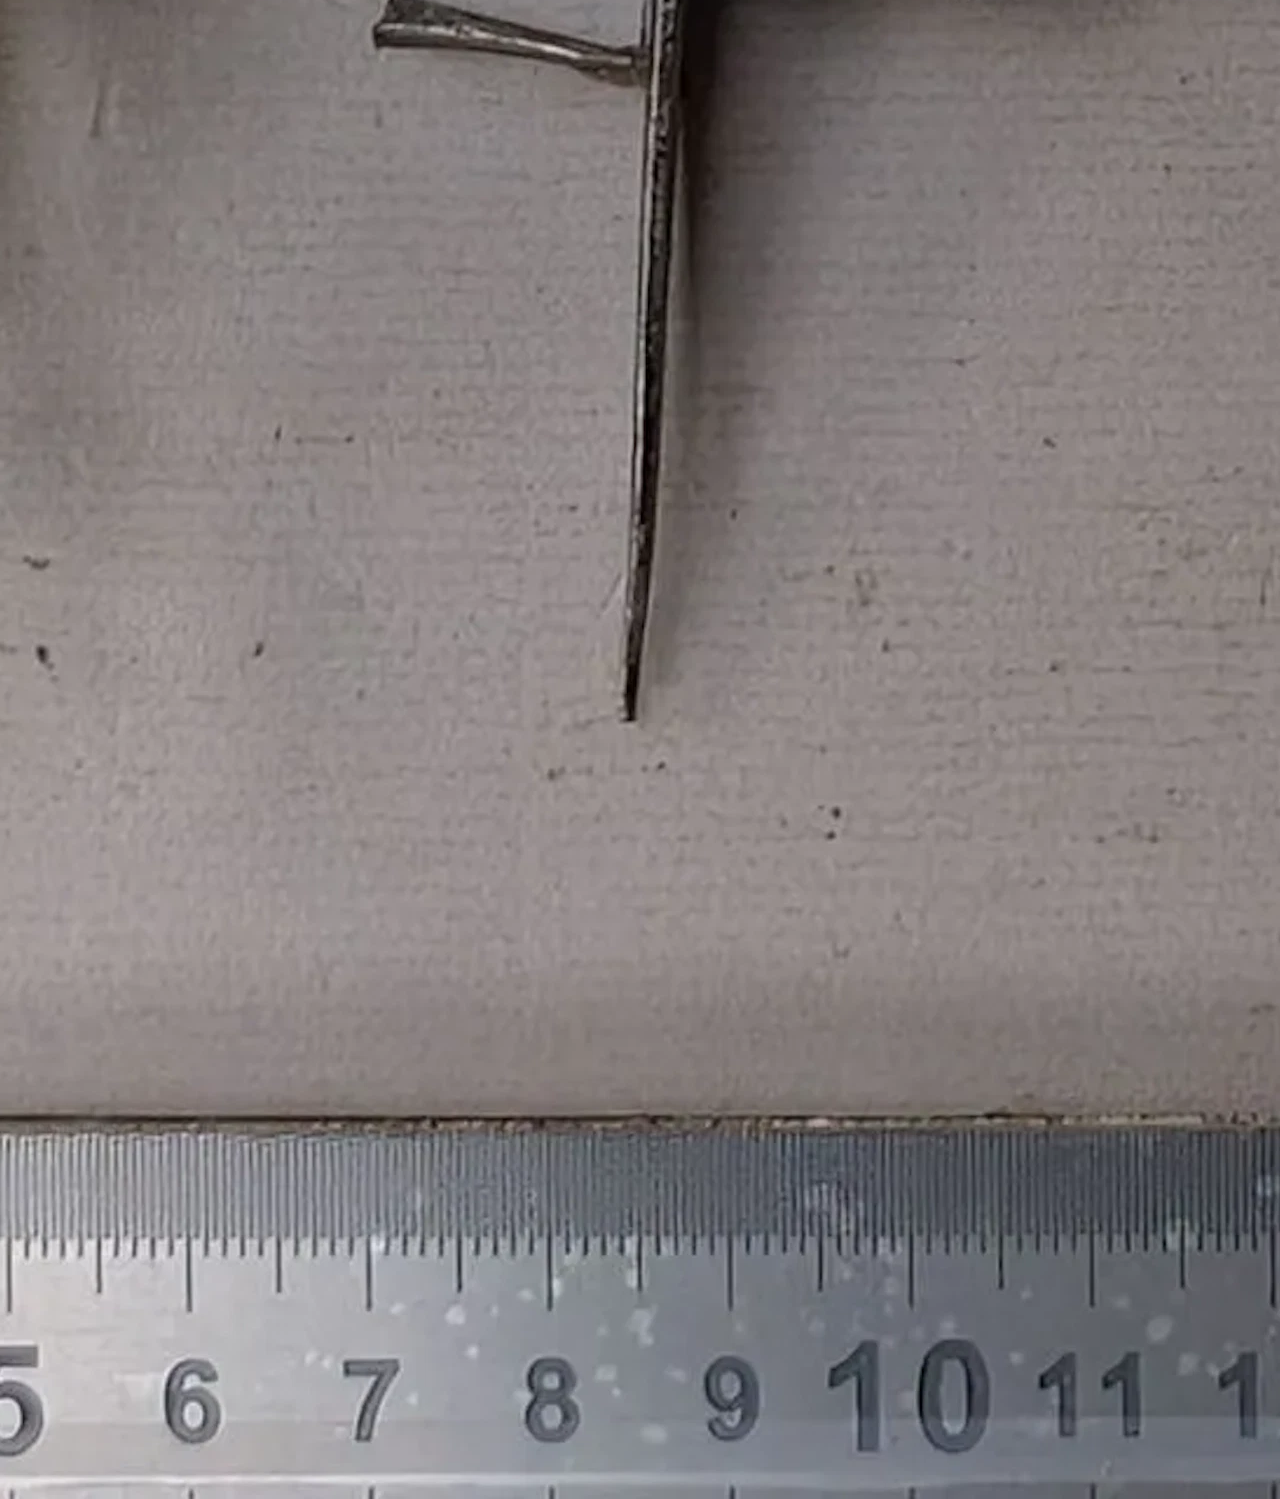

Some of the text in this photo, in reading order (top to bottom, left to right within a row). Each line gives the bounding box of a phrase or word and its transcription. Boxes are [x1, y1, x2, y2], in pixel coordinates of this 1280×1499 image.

[163, 1358, 221, 1446] 6
[342, 1358, 401, 1444] 7
[523, 1357, 580, 1444] 8
[702, 1356, 760, 1442] 9
[827, 1339, 990, 1454] 10
[1037, 1352, 1141, 1438] 11
